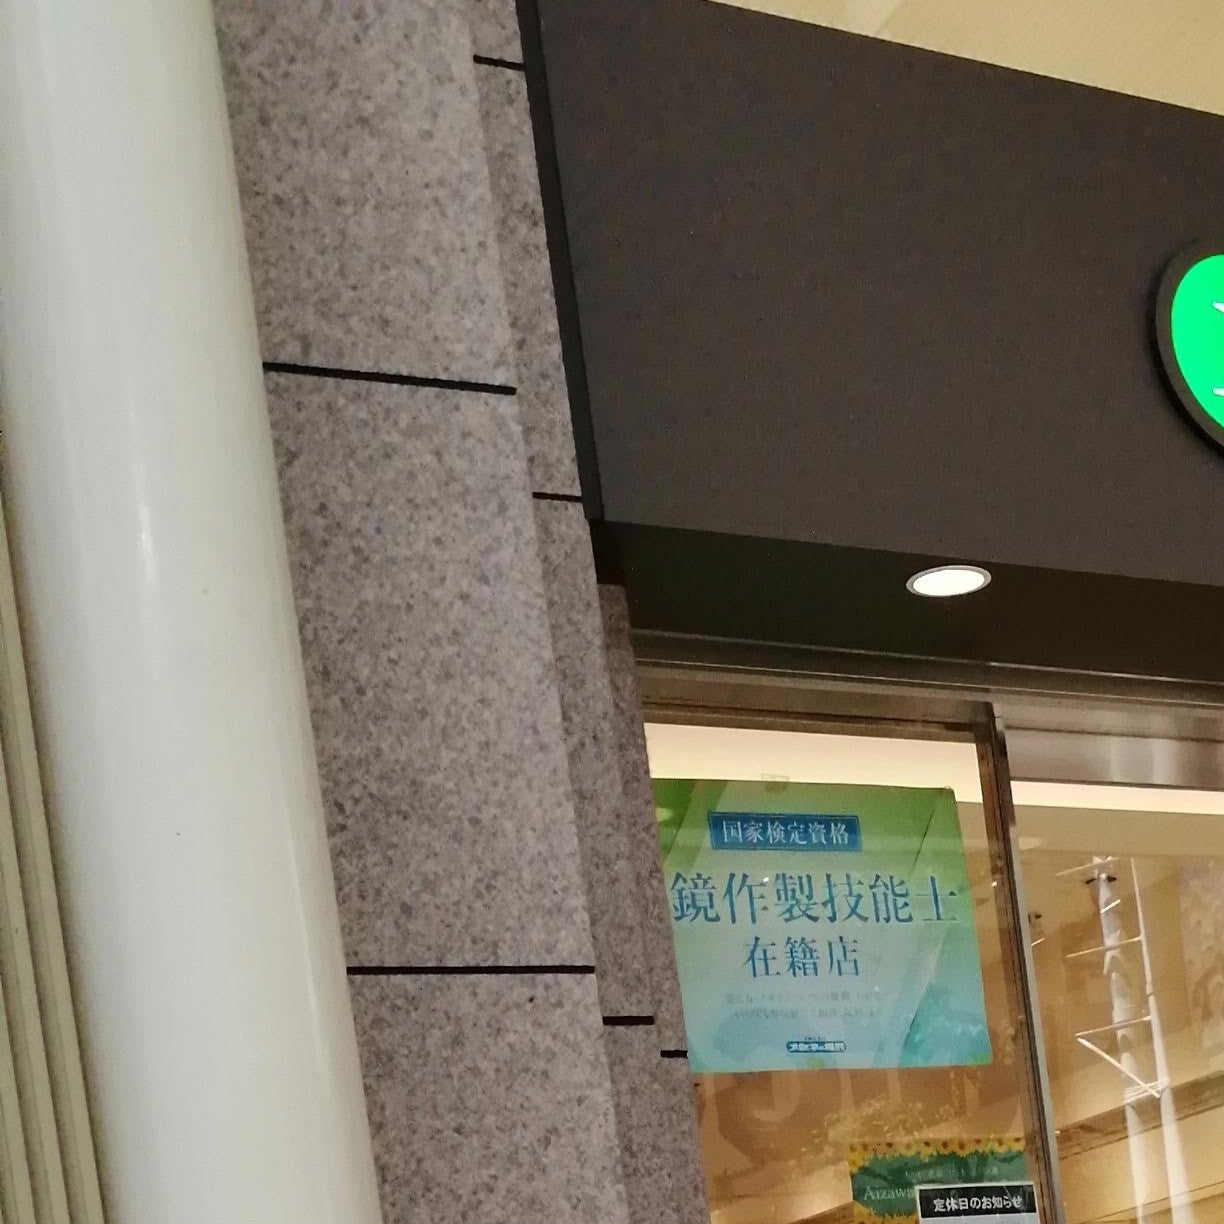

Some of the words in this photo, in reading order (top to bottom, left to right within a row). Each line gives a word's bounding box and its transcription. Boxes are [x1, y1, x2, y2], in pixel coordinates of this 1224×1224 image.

[721, 819, 850, 845] 国家検定資格
[670, 872, 960, 925] 鏡作製技能士
[743, 935, 863, 978] 在籍店
[933, 1195, 1023, 1213] 定休日のお知らせ
